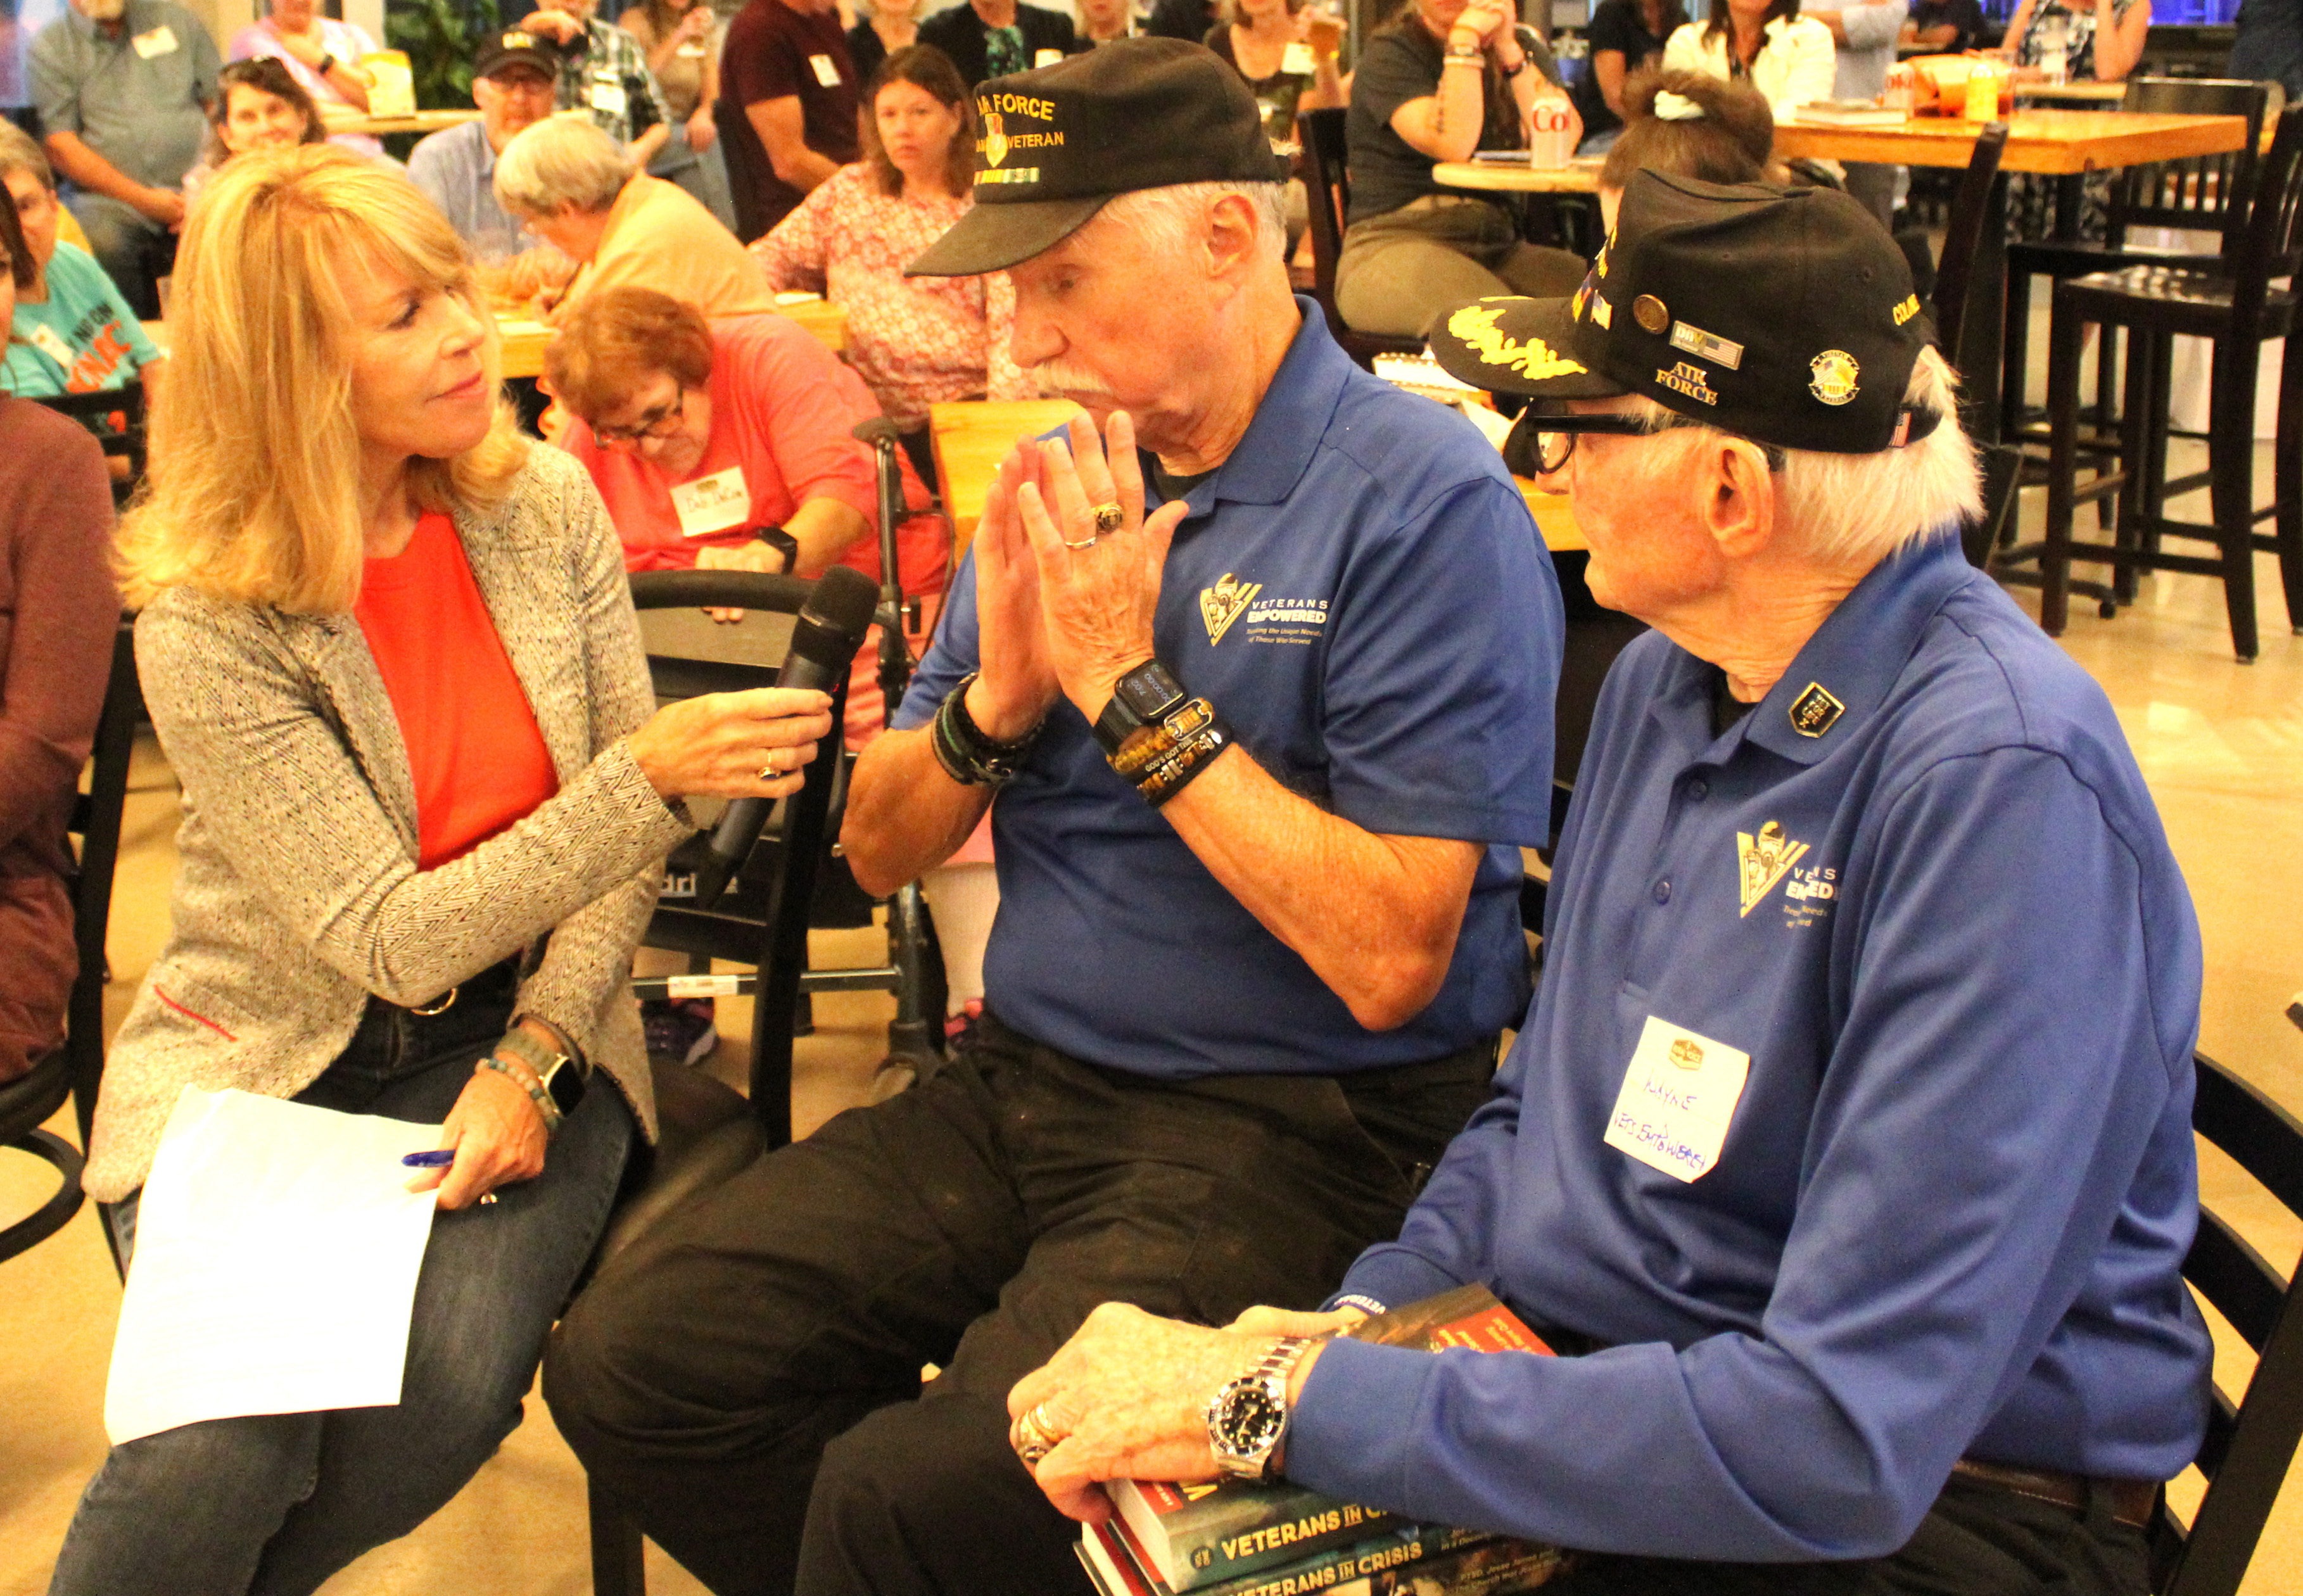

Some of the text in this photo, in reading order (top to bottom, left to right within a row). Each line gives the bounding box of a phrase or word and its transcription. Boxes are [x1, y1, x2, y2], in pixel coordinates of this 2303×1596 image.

[993, 93, 1055, 121] FORCE
[1007, 132, 1064, 149] VETERAN
[1670, 361, 1708, 386] AIR
[1655, 369, 1718, 406] FORCE
[1247, 609, 1328, 624] EMPOWERED
[1252, 598, 1329, 610] VETERANS
[1221, 1510, 1341, 1561] VETERANS
[1343, 1504, 1363, 1528] IN
[1230, 1542, 1423, 1596] ETERANS IN CRISIS
